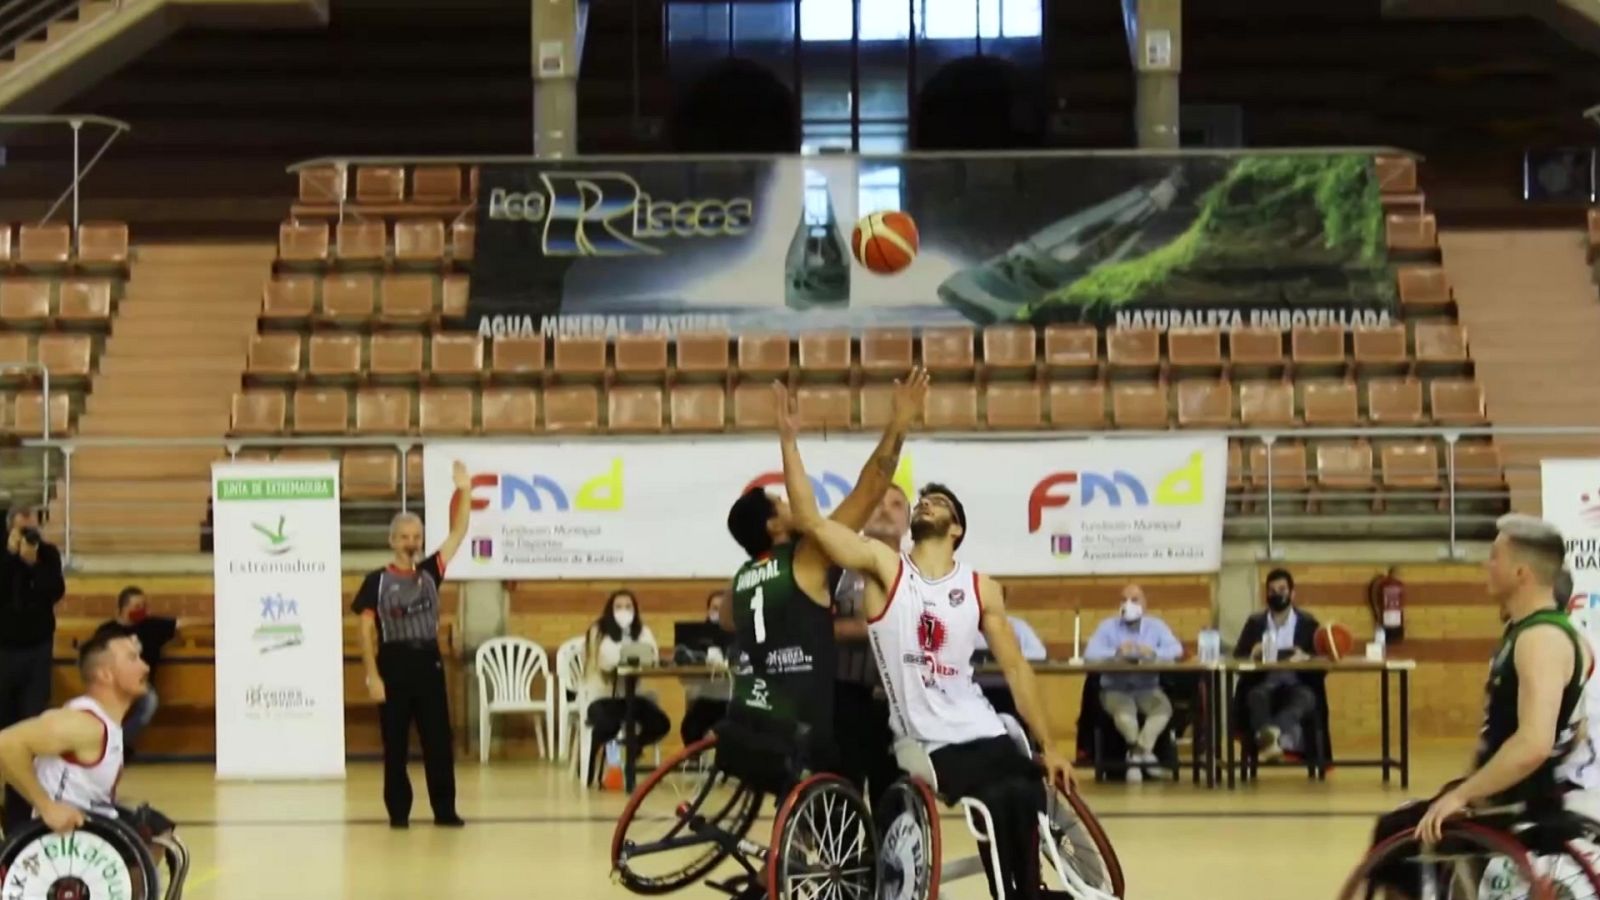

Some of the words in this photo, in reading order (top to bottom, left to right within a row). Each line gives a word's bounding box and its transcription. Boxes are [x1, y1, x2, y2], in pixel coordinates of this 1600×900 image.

[477, 314, 535, 338] AGUA
[540, 314, 627, 338] MINERAL
[1116, 309, 1243, 331] NATURALEZA
[1250, 308, 1391, 331] EMBOTELLADA
[223, 481, 249, 497] JUNTA
[251, 481, 262, 496] DE
[265, 480, 329, 496] EXTREMADURA
[1575, 556, 1600, 569] BA
[750, 586, 767, 643] 1
[43, 832, 125, 900] elkarbu
